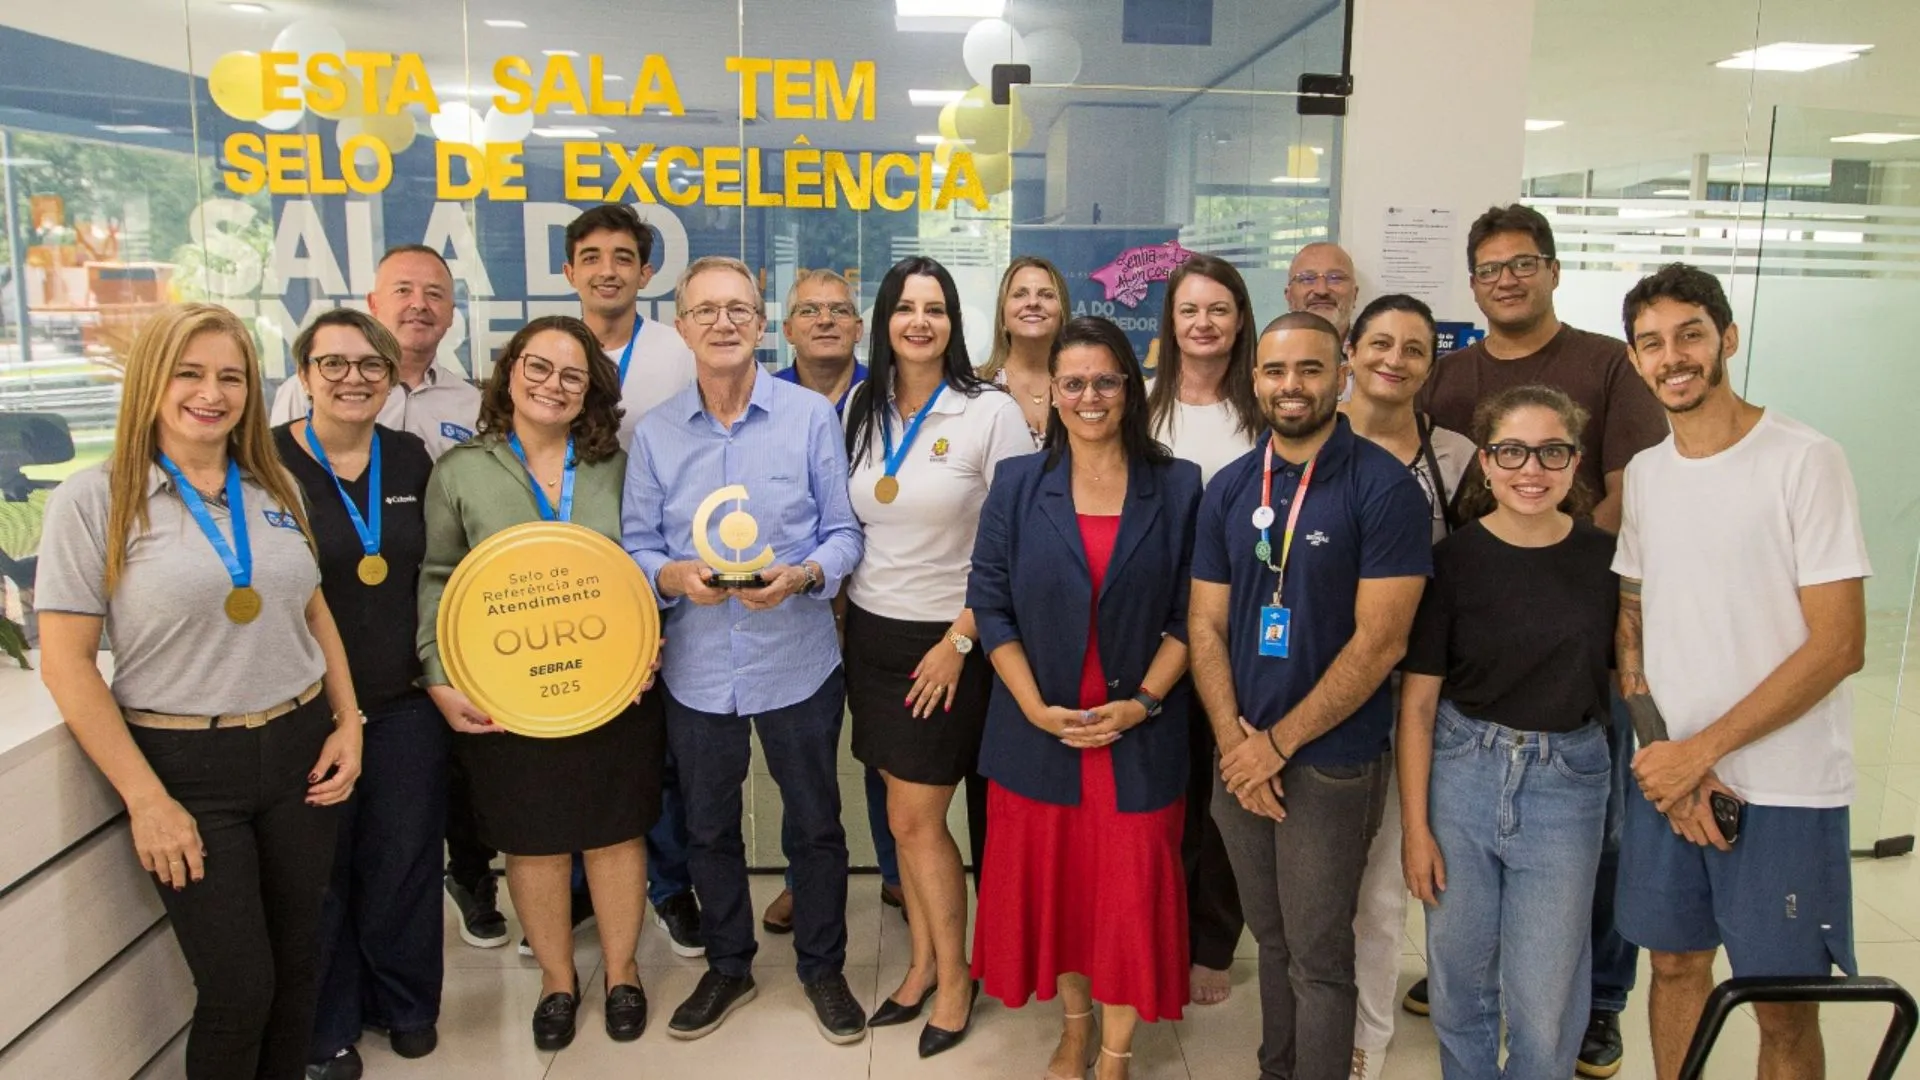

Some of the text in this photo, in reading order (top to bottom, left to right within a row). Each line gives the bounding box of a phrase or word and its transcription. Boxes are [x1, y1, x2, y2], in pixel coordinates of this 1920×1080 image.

[261, 51, 876, 121] ESTA SALA TEM
[224, 132, 989, 212] SELO DE EXCELÊNCIA
[483, 575, 600, 603] Referência em
[509, 566, 569, 585] Selo de
[487, 588, 601, 617] Atendimento
[493, 613, 607, 656] OURO
[529, 659, 583, 677] SEBRAE
[540, 680, 581, 698] 2025
